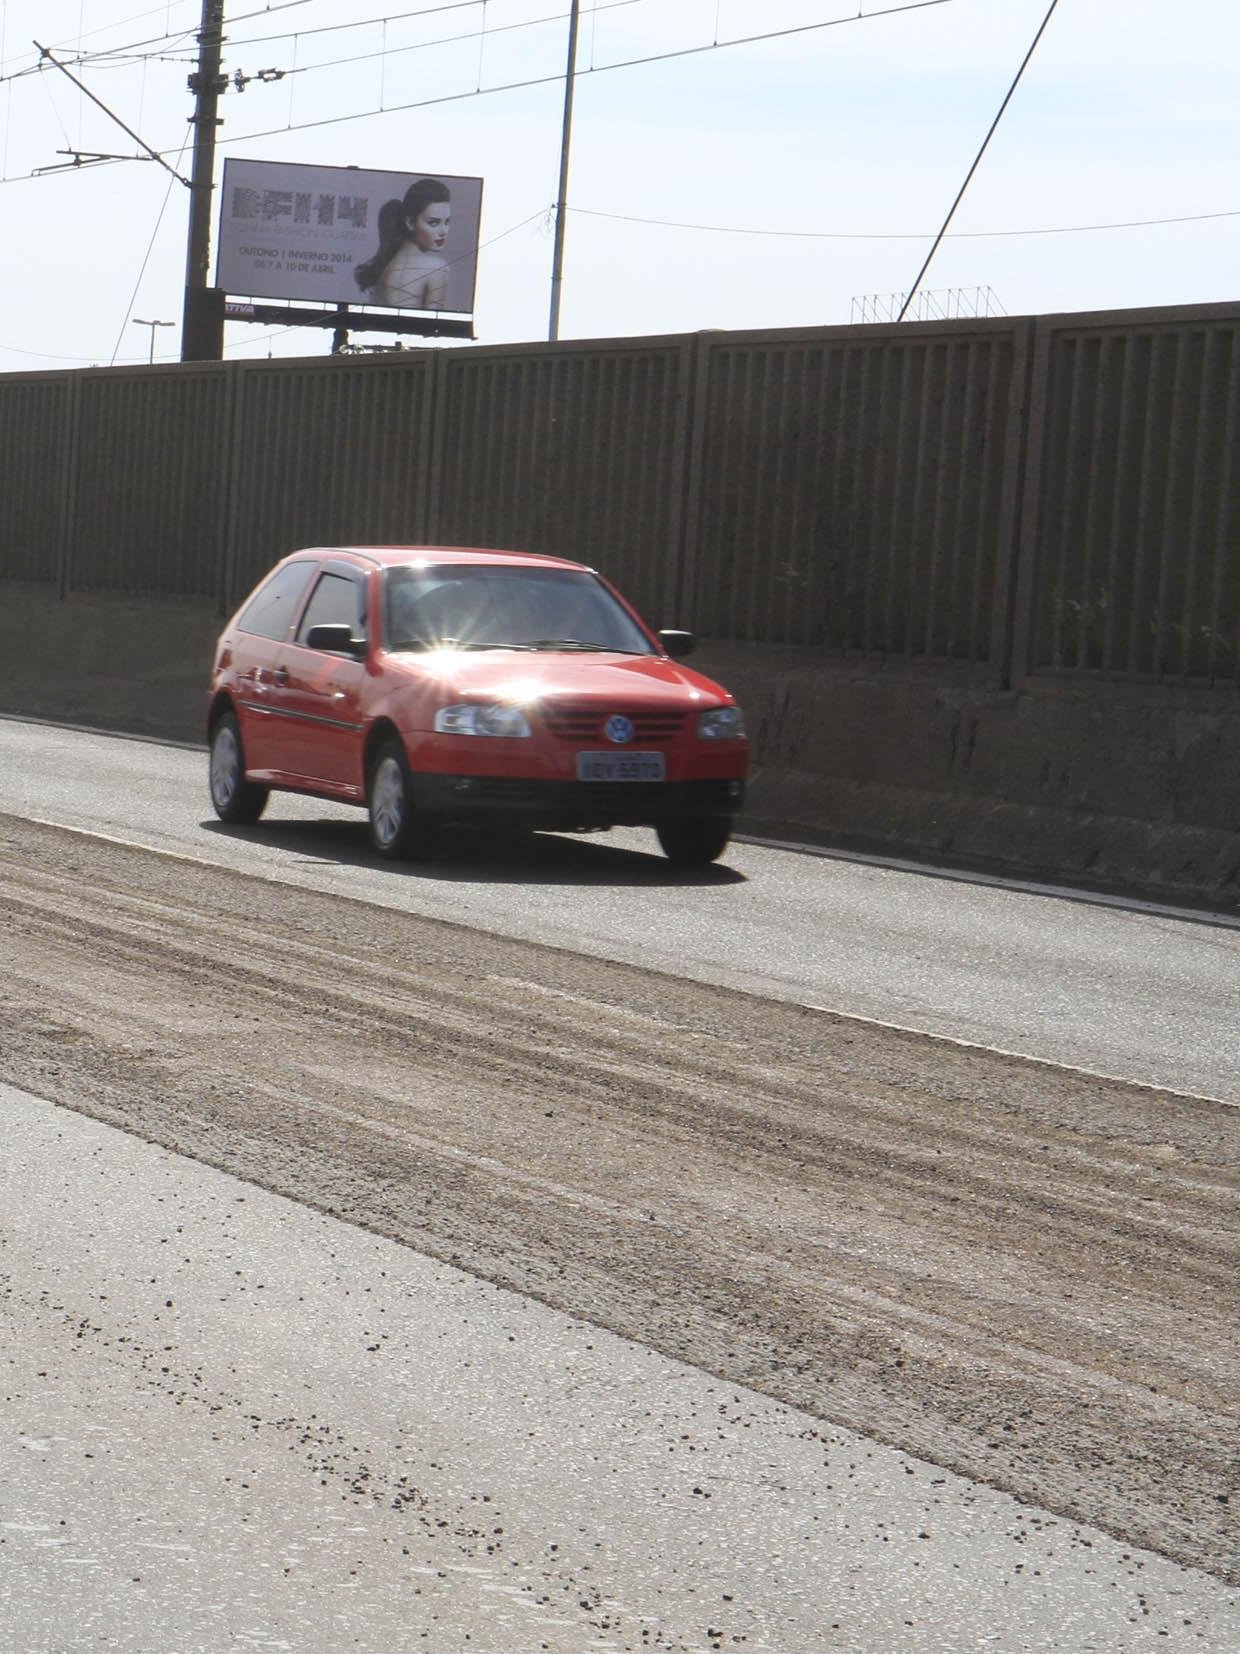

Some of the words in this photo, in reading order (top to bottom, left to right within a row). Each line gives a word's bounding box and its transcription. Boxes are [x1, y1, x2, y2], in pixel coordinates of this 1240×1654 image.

[239, 246, 279, 257] OUTONO
[288, 249, 329, 261] INVERNO
[330, 253, 352, 263] 2014
[286, 261, 297, 271] 10
[298, 263, 309, 272] DE
[311, 264, 336, 274] ABRIL
